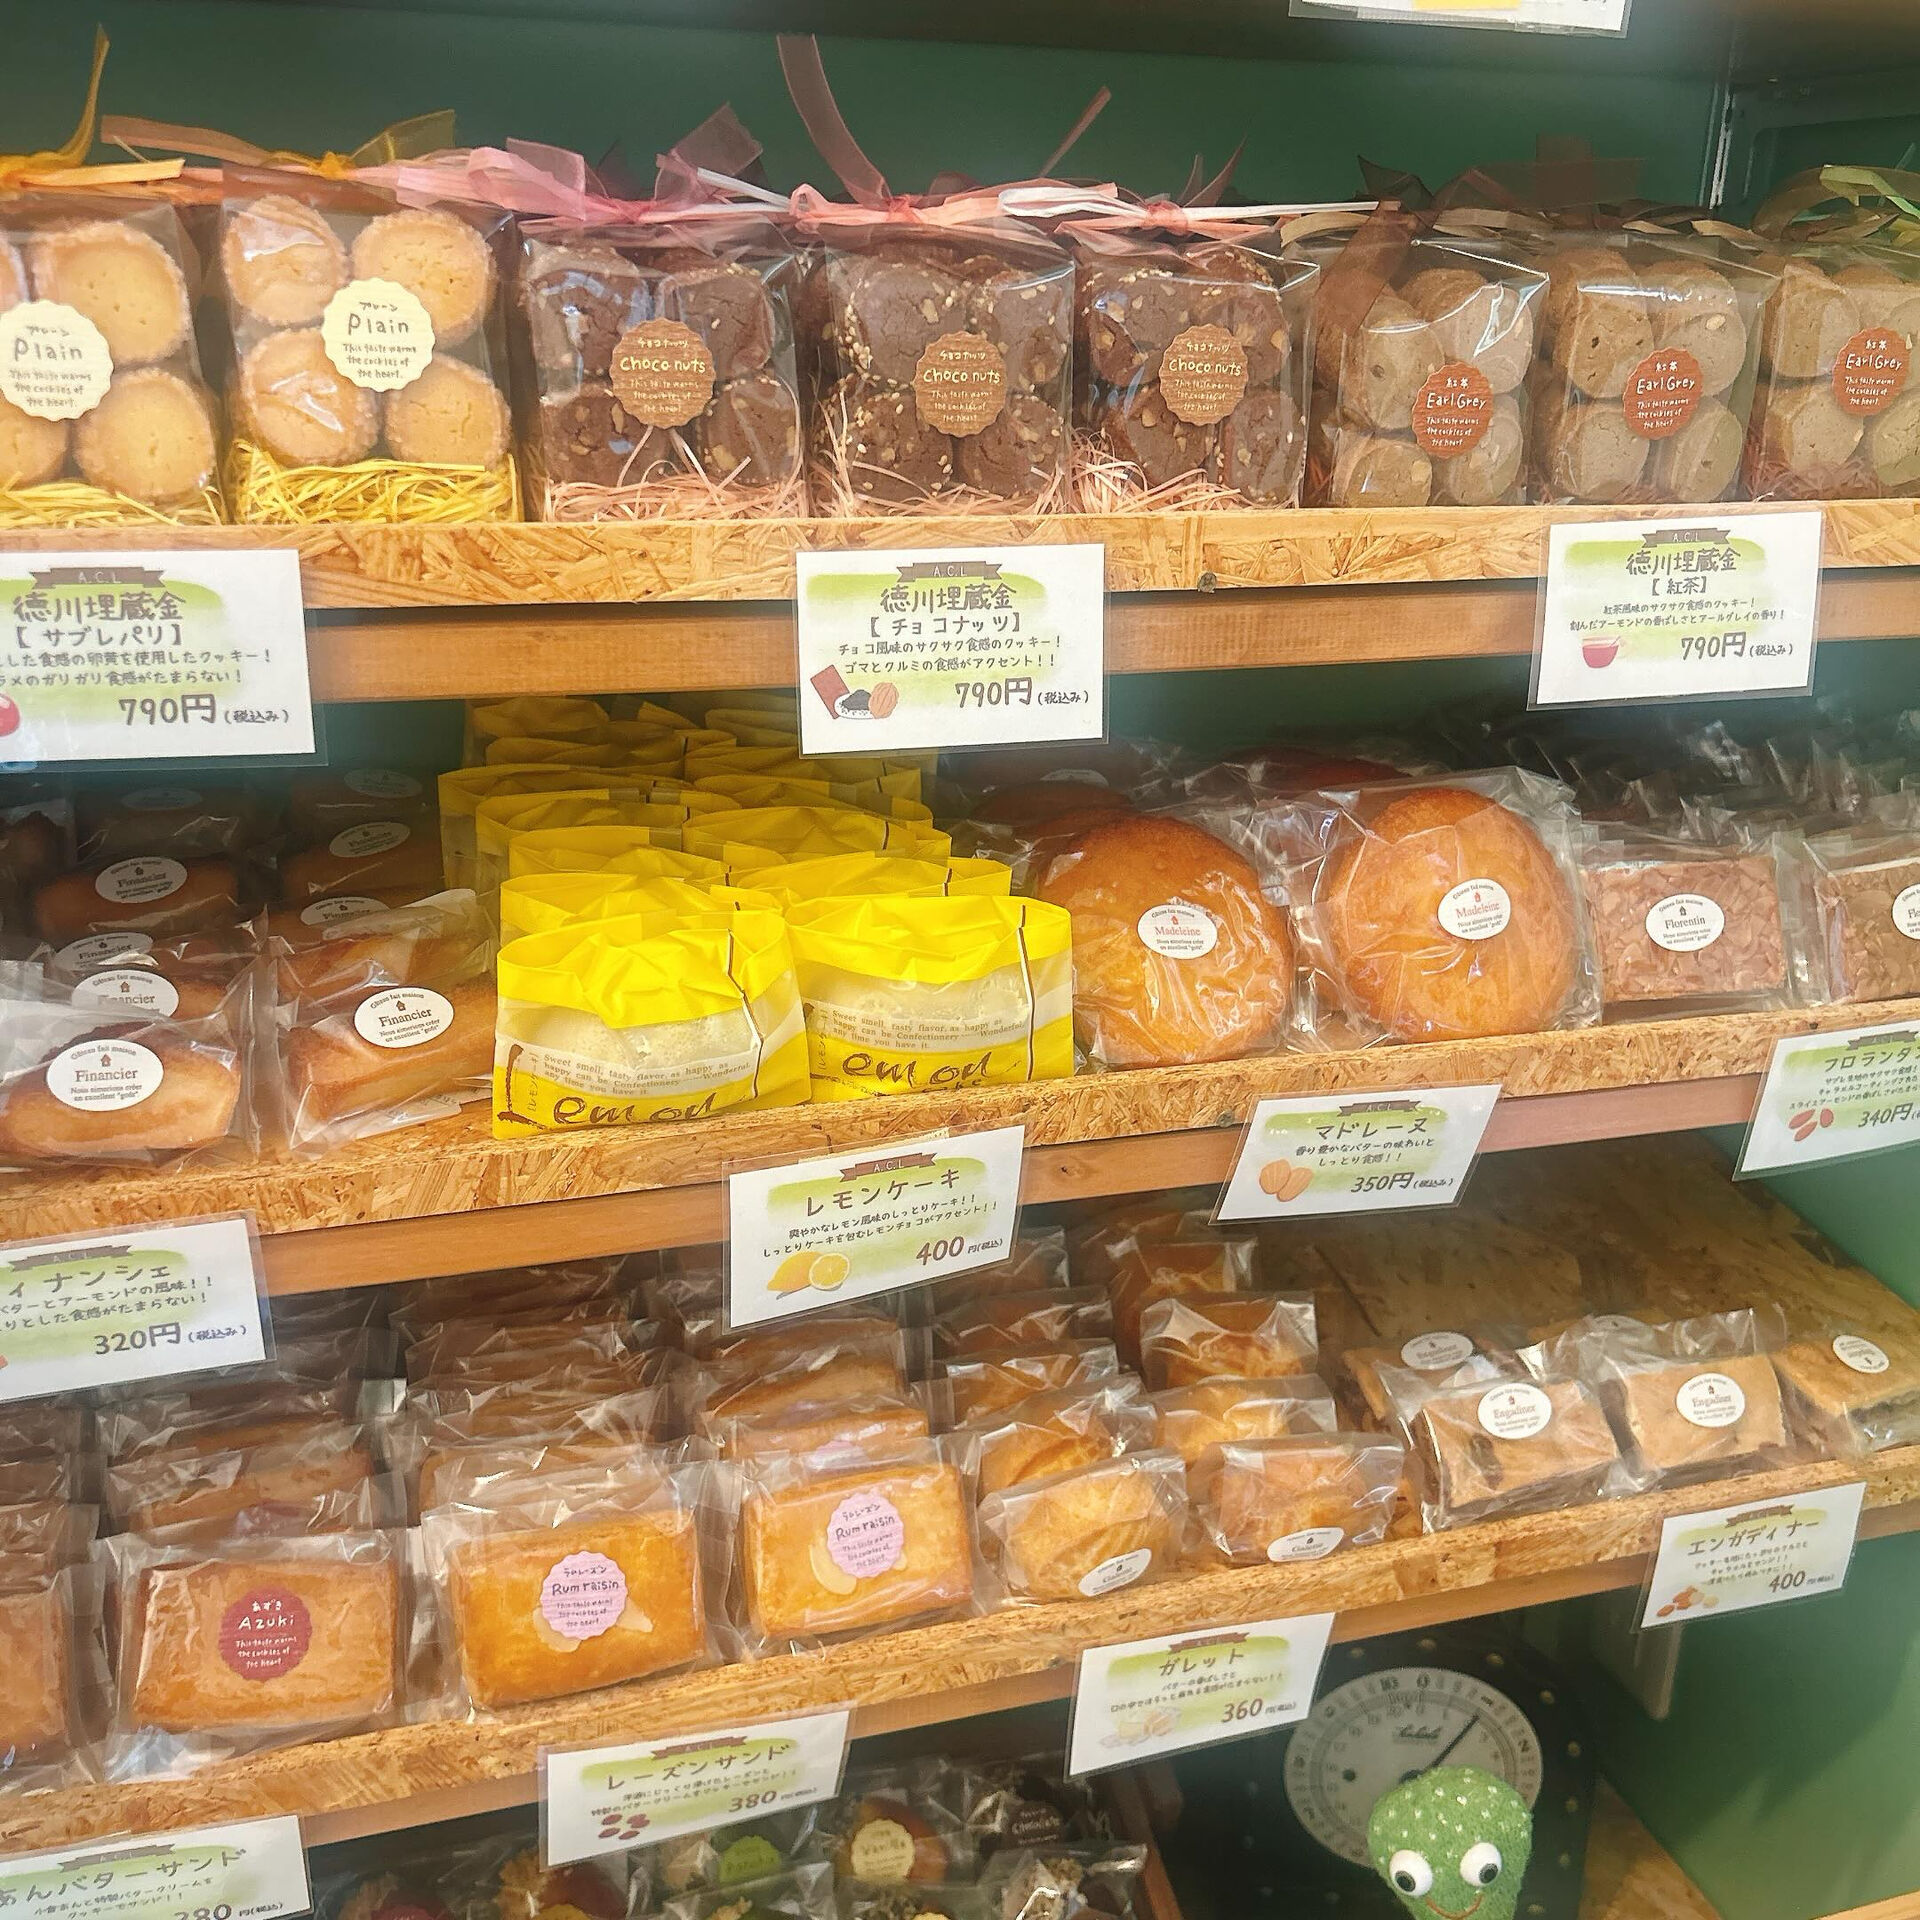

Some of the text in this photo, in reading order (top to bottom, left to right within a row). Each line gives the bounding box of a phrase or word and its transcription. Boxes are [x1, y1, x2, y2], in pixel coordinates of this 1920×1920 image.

[348, 313, 408, 335] Plain
[15, 338, 83, 361] Plain
[620, 356, 706, 373] Choco nuts
[1168, 358, 1242, 376] Choco nuts
[1845, 353, 1903, 371] Earl Grey
[923, 368, 1001, 384] Choco nuts
[1636, 376, 1695, 395] Earl Grey
[1426, 392, 1486, 410] Earl Grey
[1626, 547, 1741, 576] 徳川埋蔵金
[12, 591, 186, 624] 徳川埋蔵金
[880, 583, 1017, 614] 徳川埋蔵金
[1681, 632, 1747, 661] 790円
[0, 649, 272, 669] した食感の卵黄を使用したクッキー！
[954, 676, 1033, 709] 790円
[118, 693, 218, 727] 790円
[379, 1008, 432, 1028] Financier
[74, 1068, 139, 1083] Financier
[1858, 1102, 1914, 1128] 340円
[1316, 1117, 1429, 1140] マドレーヌ
[806, 1168, 961, 1218] レモンケーキ
[1350, 1171, 1415, 1194] 350円
[915, 1235, 965, 1267] 400
[94, 1322, 182, 1356] 320円
[835, 1515, 896, 1542] Rum raisin
[1688, 1519, 1820, 1556] エンガディナー
[552, 1580, 620, 1596] Rum raisin
[1768, 1570, 1806, 1593] 400
[238, 1614, 295, 1631] Azuki
[1158, 1647, 1244, 1677] ガレット
[1221, 1698, 1263, 1723] 360
[607, 1743, 791, 1791] レーズンサンド
[729, 1790, 778, 1814] 380
